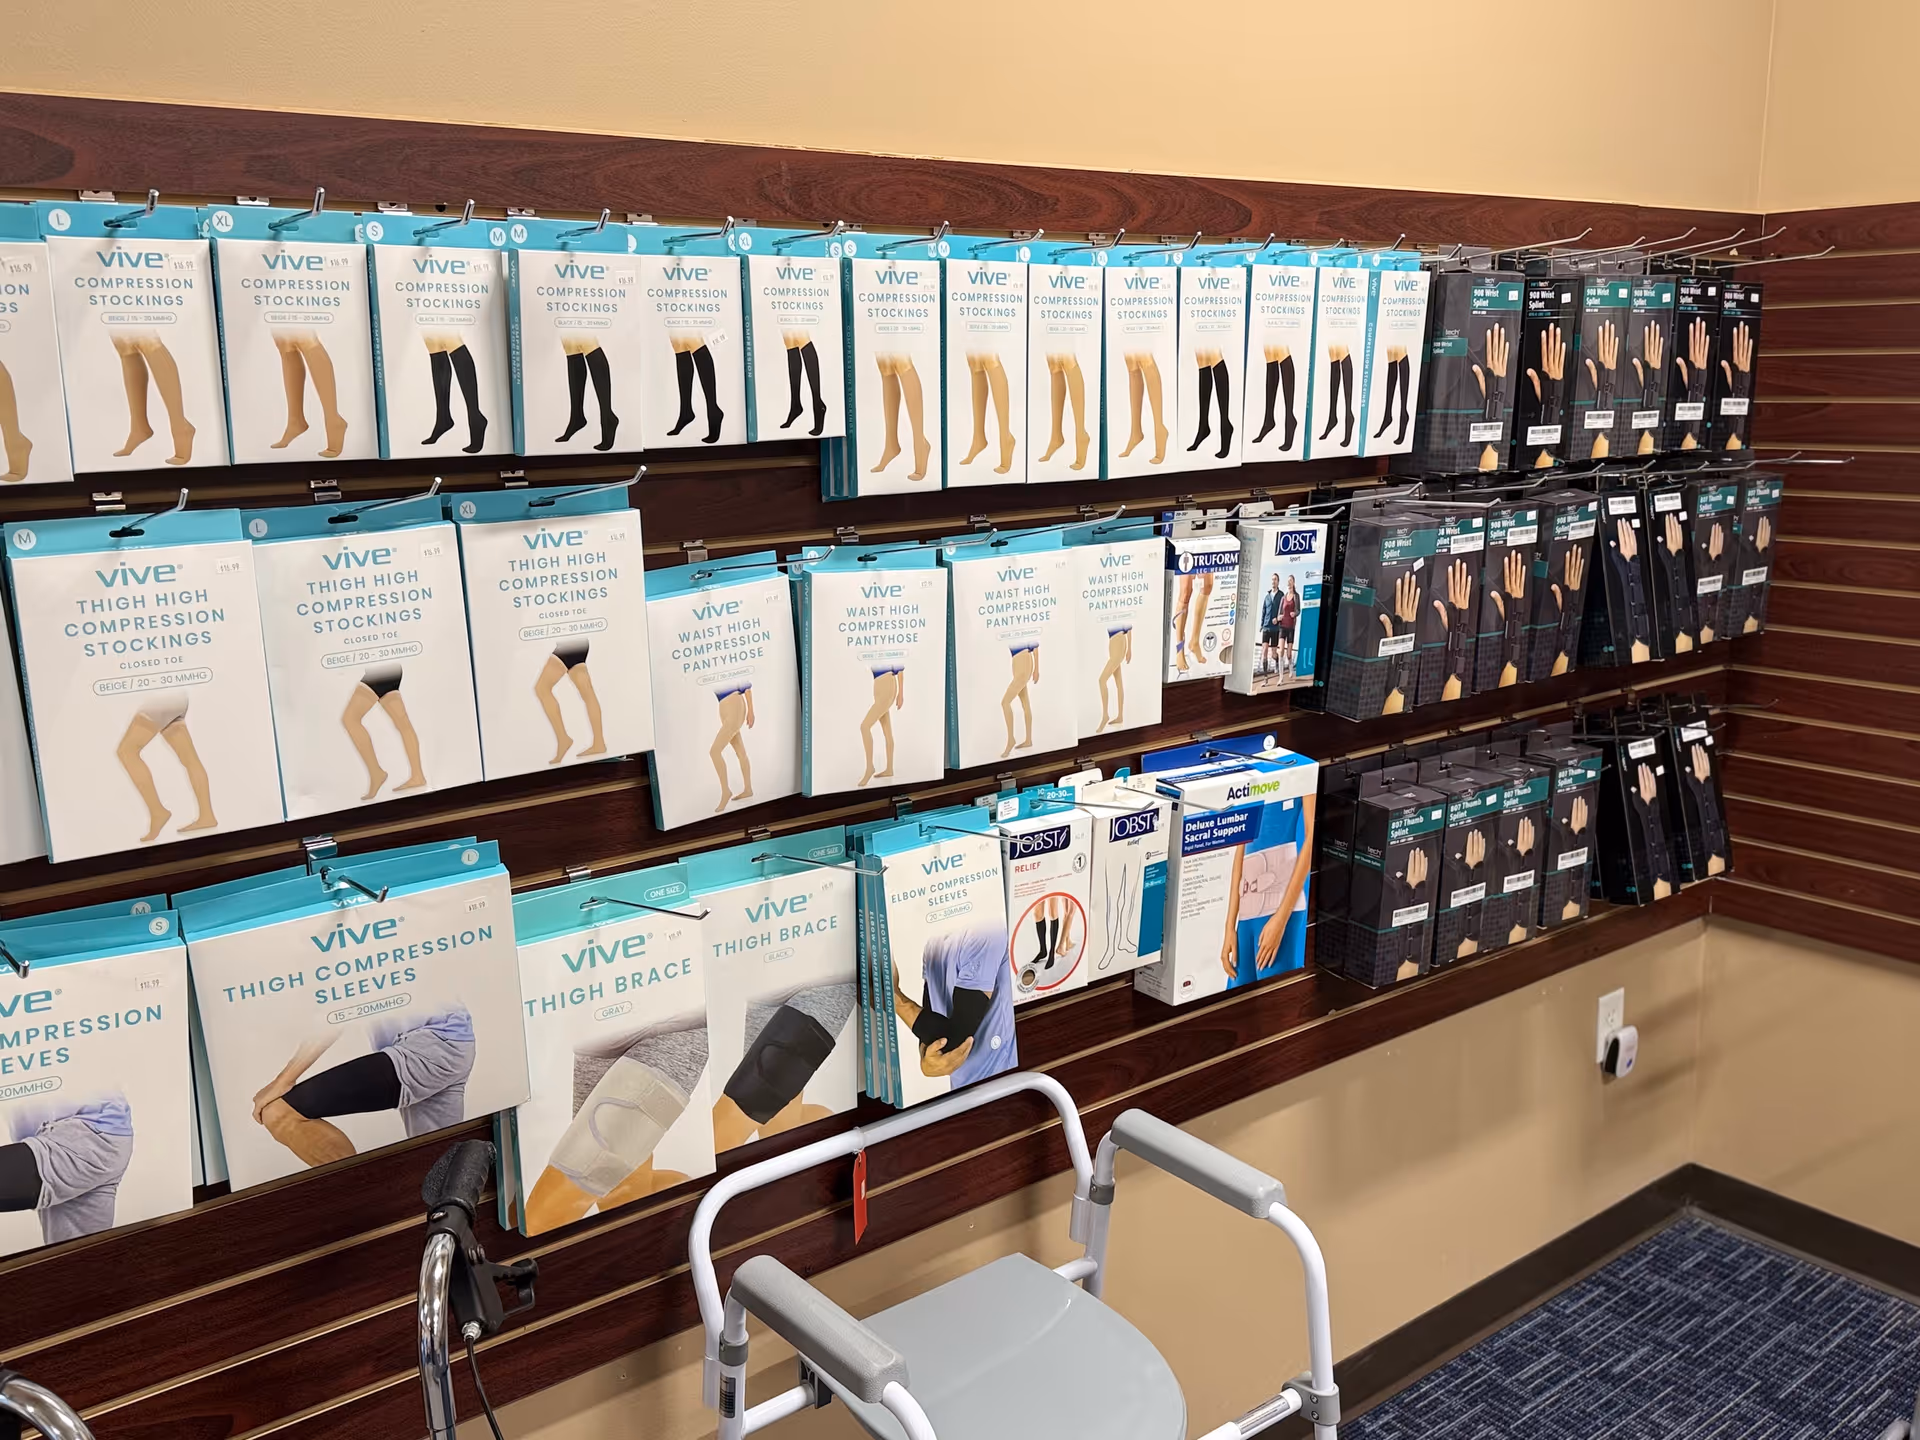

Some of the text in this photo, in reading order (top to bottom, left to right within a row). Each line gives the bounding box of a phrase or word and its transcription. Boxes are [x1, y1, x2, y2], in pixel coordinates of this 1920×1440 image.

[56, 213, 64, 226] L
[215, 215, 231, 227] XL
[371, 225, 379, 236] S
[514, 229, 524, 239] M
[492, 235, 503, 244] M
[96, 246, 163, 268] vive
[262, 249, 324, 271] vive
[413, 254, 466, 274] vive
[554, 259, 605, 279] vive
[662, 263, 708, 281] vive
[776, 262, 814, 281] vive
[875, 266, 918, 285] vive
[967, 266, 1007, 286] vive
[74, 277, 193, 289] COMPRESSION
[241, 278, 350, 291] COMPRESSION
[395, 282, 489, 294] COMPRESSION
[1048, 271, 1085, 289] vive
[89, 294, 184, 306] STOCKINGS
[536, 286, 626, 298] COMPRESSION
[647, 288, 728, 298] COMPRESSION
[763, 287, 830, 297] COMPRESSION
[858, 293, 936, 303] COMPRESSION
[951, 292, 1023, 304] COMPRESSION
[254, 295, 341, 307] STOCKINGS
[406, 298, 481, 309] STOCKINGS
[546, 302, 618, 313] STOCKINGS
[656, 303, 721, 313] STOCKINGS
[771, 301, 824, 311] STOCKINGS
[1033, 296, 1099, 306] COMPRESSION
[867, 308, 929, 318] STOCKINGS
[959, 307, 1016, 317] STOCKINGS
[1040, 310, 1093, 320] STOCKINGS
[461, 504, 474, 515] XL
[255, 523, 261, 533] L
[18, 533, 32, 545] M
[523, 527, 583, 550] vive
[1276, 532, 1312, 555] JOBST
[1397, 539, 1412, 547] Wrist
[321, 546, 392, 571] vive
[508, 551, 607, 572] THIGH HIGH
[1099, 552, 1131, 568] vive
[1193, 552, 1239, 567] TRUFORM
[1383, 550, 1400, 559] Splint
[95, 561, 176, 588] vive
[306, 570, 419, 595] THIGH HIGH
[499, 567, 618, 592] COMPRESSION
[996, 565, 1034, 583] vive
[1088, 571, 1144, 586] WAIST HIGH
[512, 587, 608, 609] STOCKINGS
[860, 582, 902, 598] vive
[984, 584, 1050, 601] WAIST HIGH
[1082, 582, 1149, 599] COMPRESSION
[76, 589, 208, 614] THIGH HIGH
[296, 587, 433, 616] COMPRESSION
[692, 600, 739, 620] vive
[978, 597, 1057, 616] COMPRESSION
[1088, 596, 1143, 611] PANTYHOSE
[538, 607, 587, 620] CLOSED TOE
[846, 604, 919, 618] WAIST HIGH
[64, 608, 226, 637] COMPRESSION
[313, 608, 422, 634] STOCKINGS
[838, 618, 926, 633] COMPRESSION
[986, 611, 1051, 629] PANTYHOSE
[523, 620, 604, 638] BEIGE 20 30 MMHG
[678, 617, 761, 644] WAIST HIGH
[84, 631, 212, 657] STOCKINGS
[343, 631, 398, 645] CLOSED TOE
[671, 631, 771, 660] COMPRESSION
[847, 632, 919, 647] PANTYHOSE
[119, 655, 184, 670] CLOSED TOE
[326, 645, 418, 667] BEIGE 20 30 MMHG
[683, 647, 764, 673] PANTYHOSE
[99, 671, 208, 693] BEIGE 20 30 MMHG
[1046, 789, 1067, 799] 20-30
[1226, 779, 1280, 801] Actimove
[1462, 799, 1482, 810] Thumb
[1185, 813, 1249, 833] Deluxe Lumbar
[1403, 816, 1424, 826] Thumb
[1449, 810, 1467, 821] Splint
[1110, 811, 1153, 842] JOBST
[1184, 823, 1246, 844] Sacral Support
[1390, 828, 1409, 838] Splint
[812, 846, 839, 858] ONE SIZE
[1014, 829, 1061, 858] JOBST
[921, 853, 963, 876] vive
[1014, 861, 1041, 873] RELIEF
[650, 886, 681, 899] ONE SIZE
[891, 887, 927, 904] ELBOW
[929, 867, 999, 893] COMPRESSION
[928, 889, 968, 907] SLEEVES
[745, 894, 807, 924] vive
[155, 921, 163, 931] S
[310, 918, 398, 953] vive
[713, 931, 771, 957] THIGH
[779, 915, 838, 942] BRACE
[561, 934, 646, 973] vive
[222, 925, 493, 1003] THIGH COMPRESSION
[314, 967, 417, 1005] SLEEVES
[524, 958, 692, 1018] THIGH BRACE
[333, 997, 405, 1022] 15 20MMHG
[601, 1004, 626, 1018] GRAY
